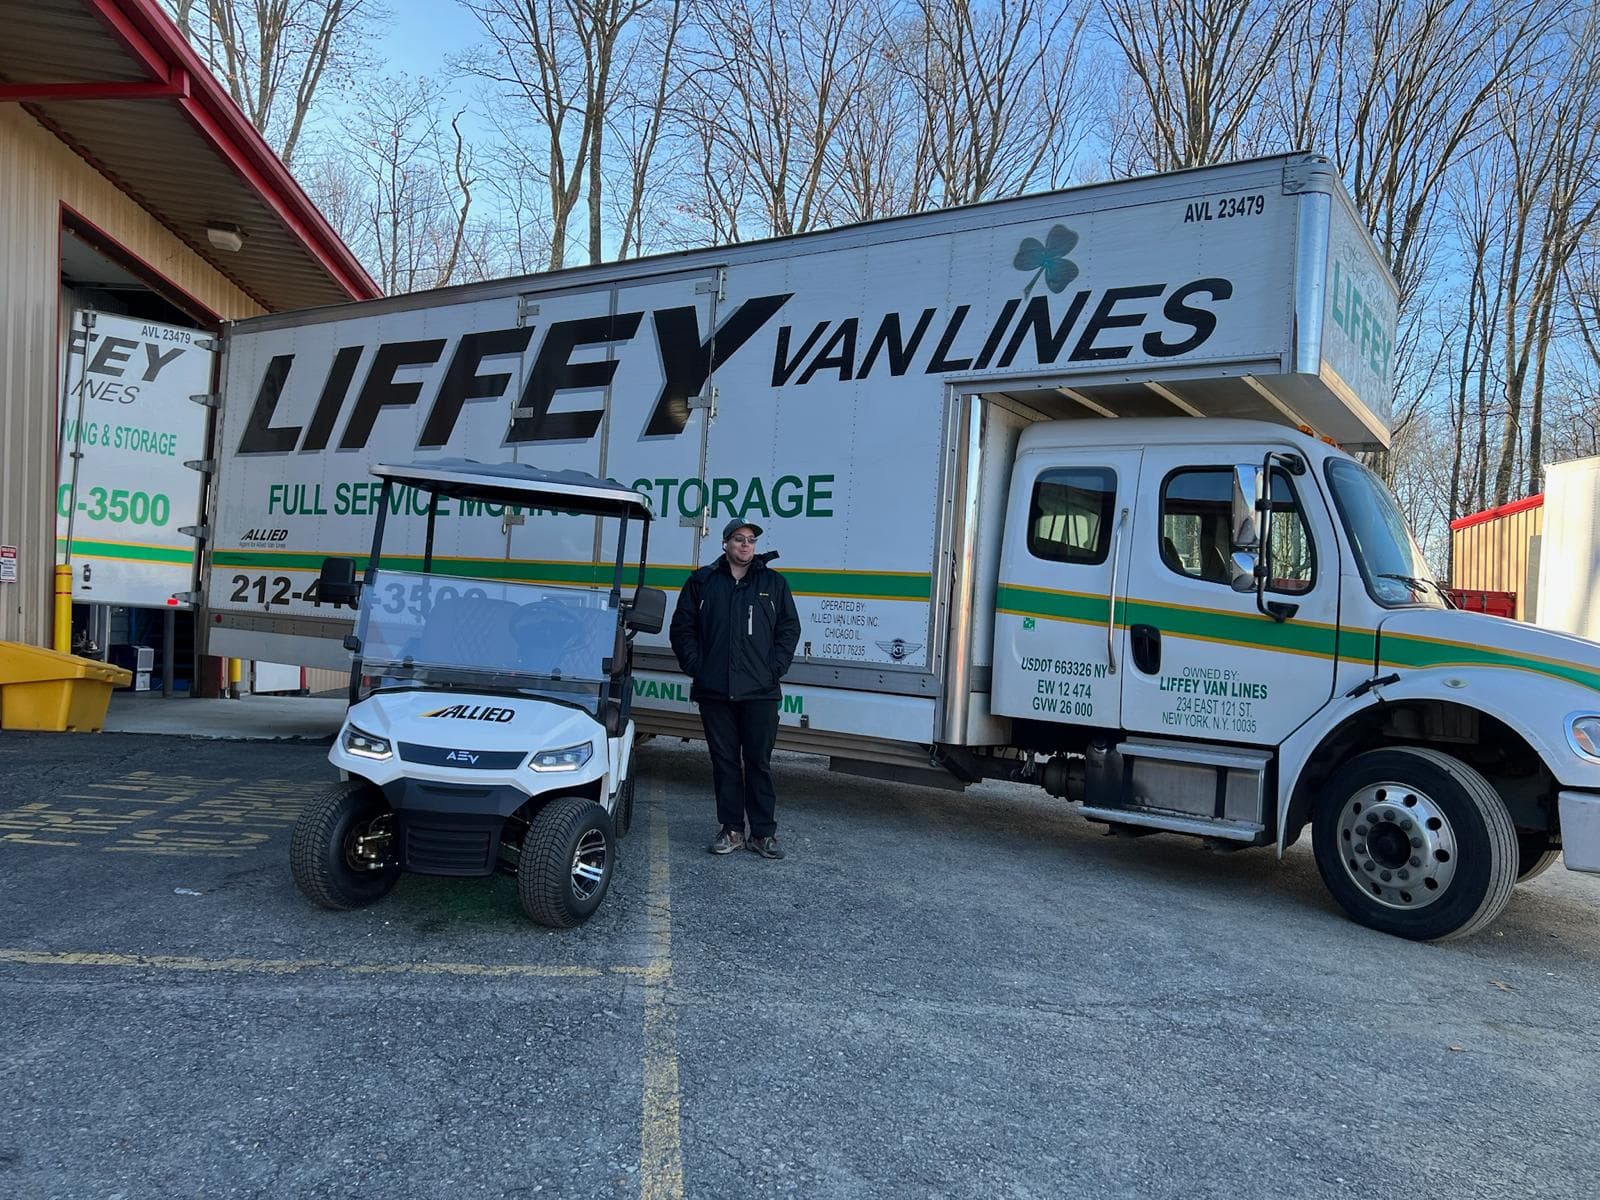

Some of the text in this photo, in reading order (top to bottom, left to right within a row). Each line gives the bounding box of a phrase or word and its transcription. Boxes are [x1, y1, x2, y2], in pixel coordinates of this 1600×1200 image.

[1184, 195, 1265, 224] AVL 23479
[1332, 258, 1393, 385] LIFFEY
[141, 325, 191, 344] AVL 23479
[236, 293, 795, 456] LIFFEY
[771, 306, 937, 388] VAN
[924, 277, 1234, 375] LINES
[101, 424, 110, 447] &
[114, 426, 177, 457] STORAGE
[268, 484, 328, 516] FULL
[241, 528, 289, 542] ALLIED
[820, 599, 855, 612] OPERATED
[811, 613, 832, 624] ALLIED
[834, 614, 846, 625] VAN
[847, 615, 866, 626] LINES
[825, 627, 854, 640] CHICAGO
[822, 643, 832, 654] US
[833, 643, 846, 655] DOT
[1021, 656, 1108, 679] USDOT 663326 NY
[1183, 667, 1221, 680] OWNED
[1037, 679, 1092, 699] EW 12 474
[1159, 676, 1268, 700] LIFFEY VAN LINES
[436, 704, 516, 723] ALLIED
[1032, 697, 1093, 718] GVW 26 000
[1176, 697, 1192, 712] 234
[1195, 698, 1219, 714] EAST
[1221, 701, 1236, 716] 121
[1162, 712, 1183, 726] NEW
[1213, 717, 1230, 730] N.Y.
[1232, 719, 1257, 733] 10035
[446, 751, 480, 765] AEV
